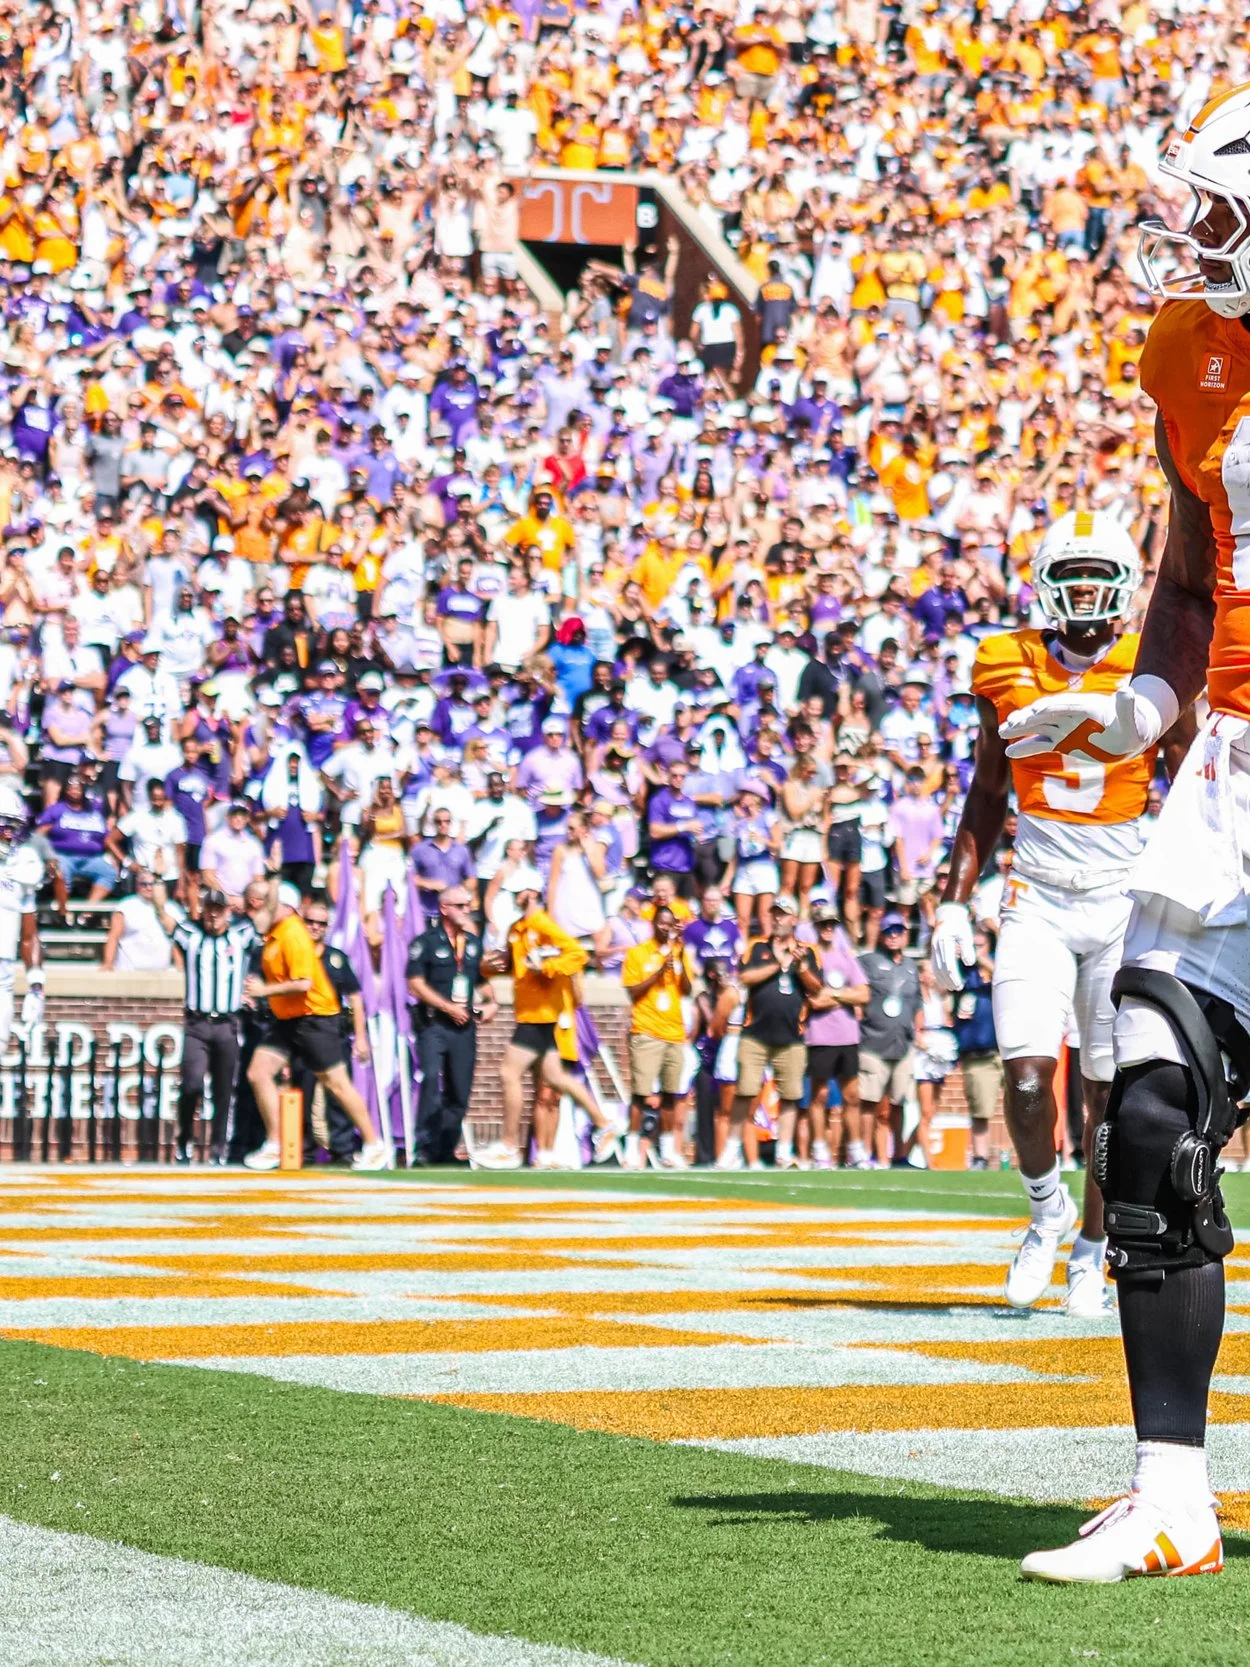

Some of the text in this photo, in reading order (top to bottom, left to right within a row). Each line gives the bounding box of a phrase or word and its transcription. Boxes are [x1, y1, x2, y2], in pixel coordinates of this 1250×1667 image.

[1205, 374, 1221, 382] FIRST
[1200, 381, 1225, 389] HORIZON
[1196, 1150, 1205, 1193] DONJOY
